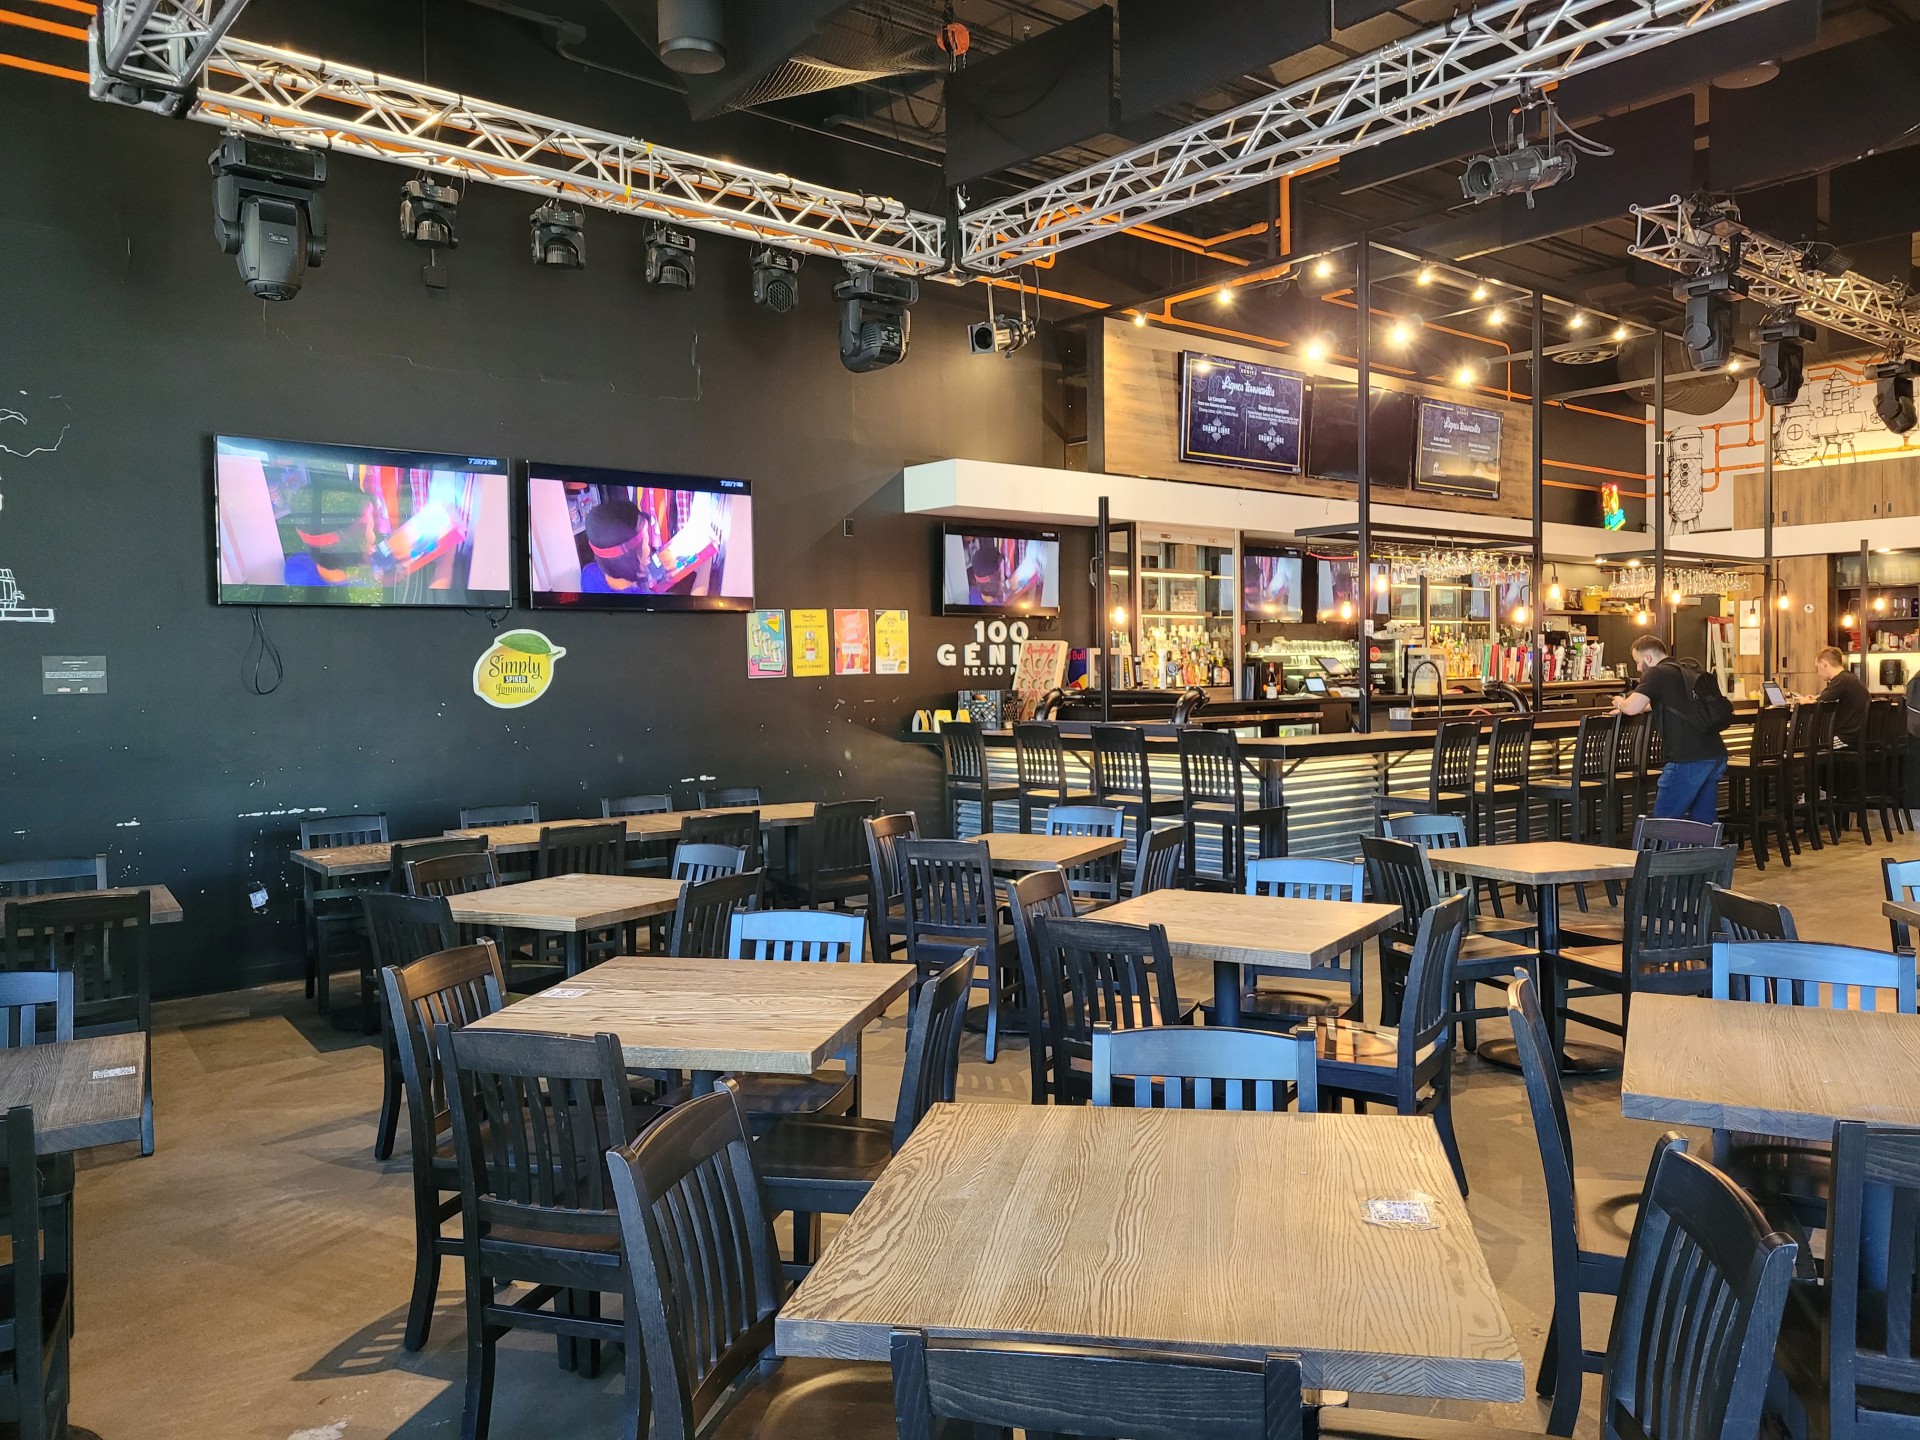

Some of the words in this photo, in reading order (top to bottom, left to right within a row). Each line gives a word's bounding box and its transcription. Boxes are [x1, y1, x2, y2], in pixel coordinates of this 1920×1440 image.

[1222, 376, 1244, 394] Lignes
[974, 620, 1029, 643] 100
[936, 642, 1021, 666] GÉNI
[1072, 649, 1086, 660] Bull
[488, 654, 543, 680] Simply
[963, 666, 1004, 676] RESTO
[496, 683, 535, 696] Lemonade
